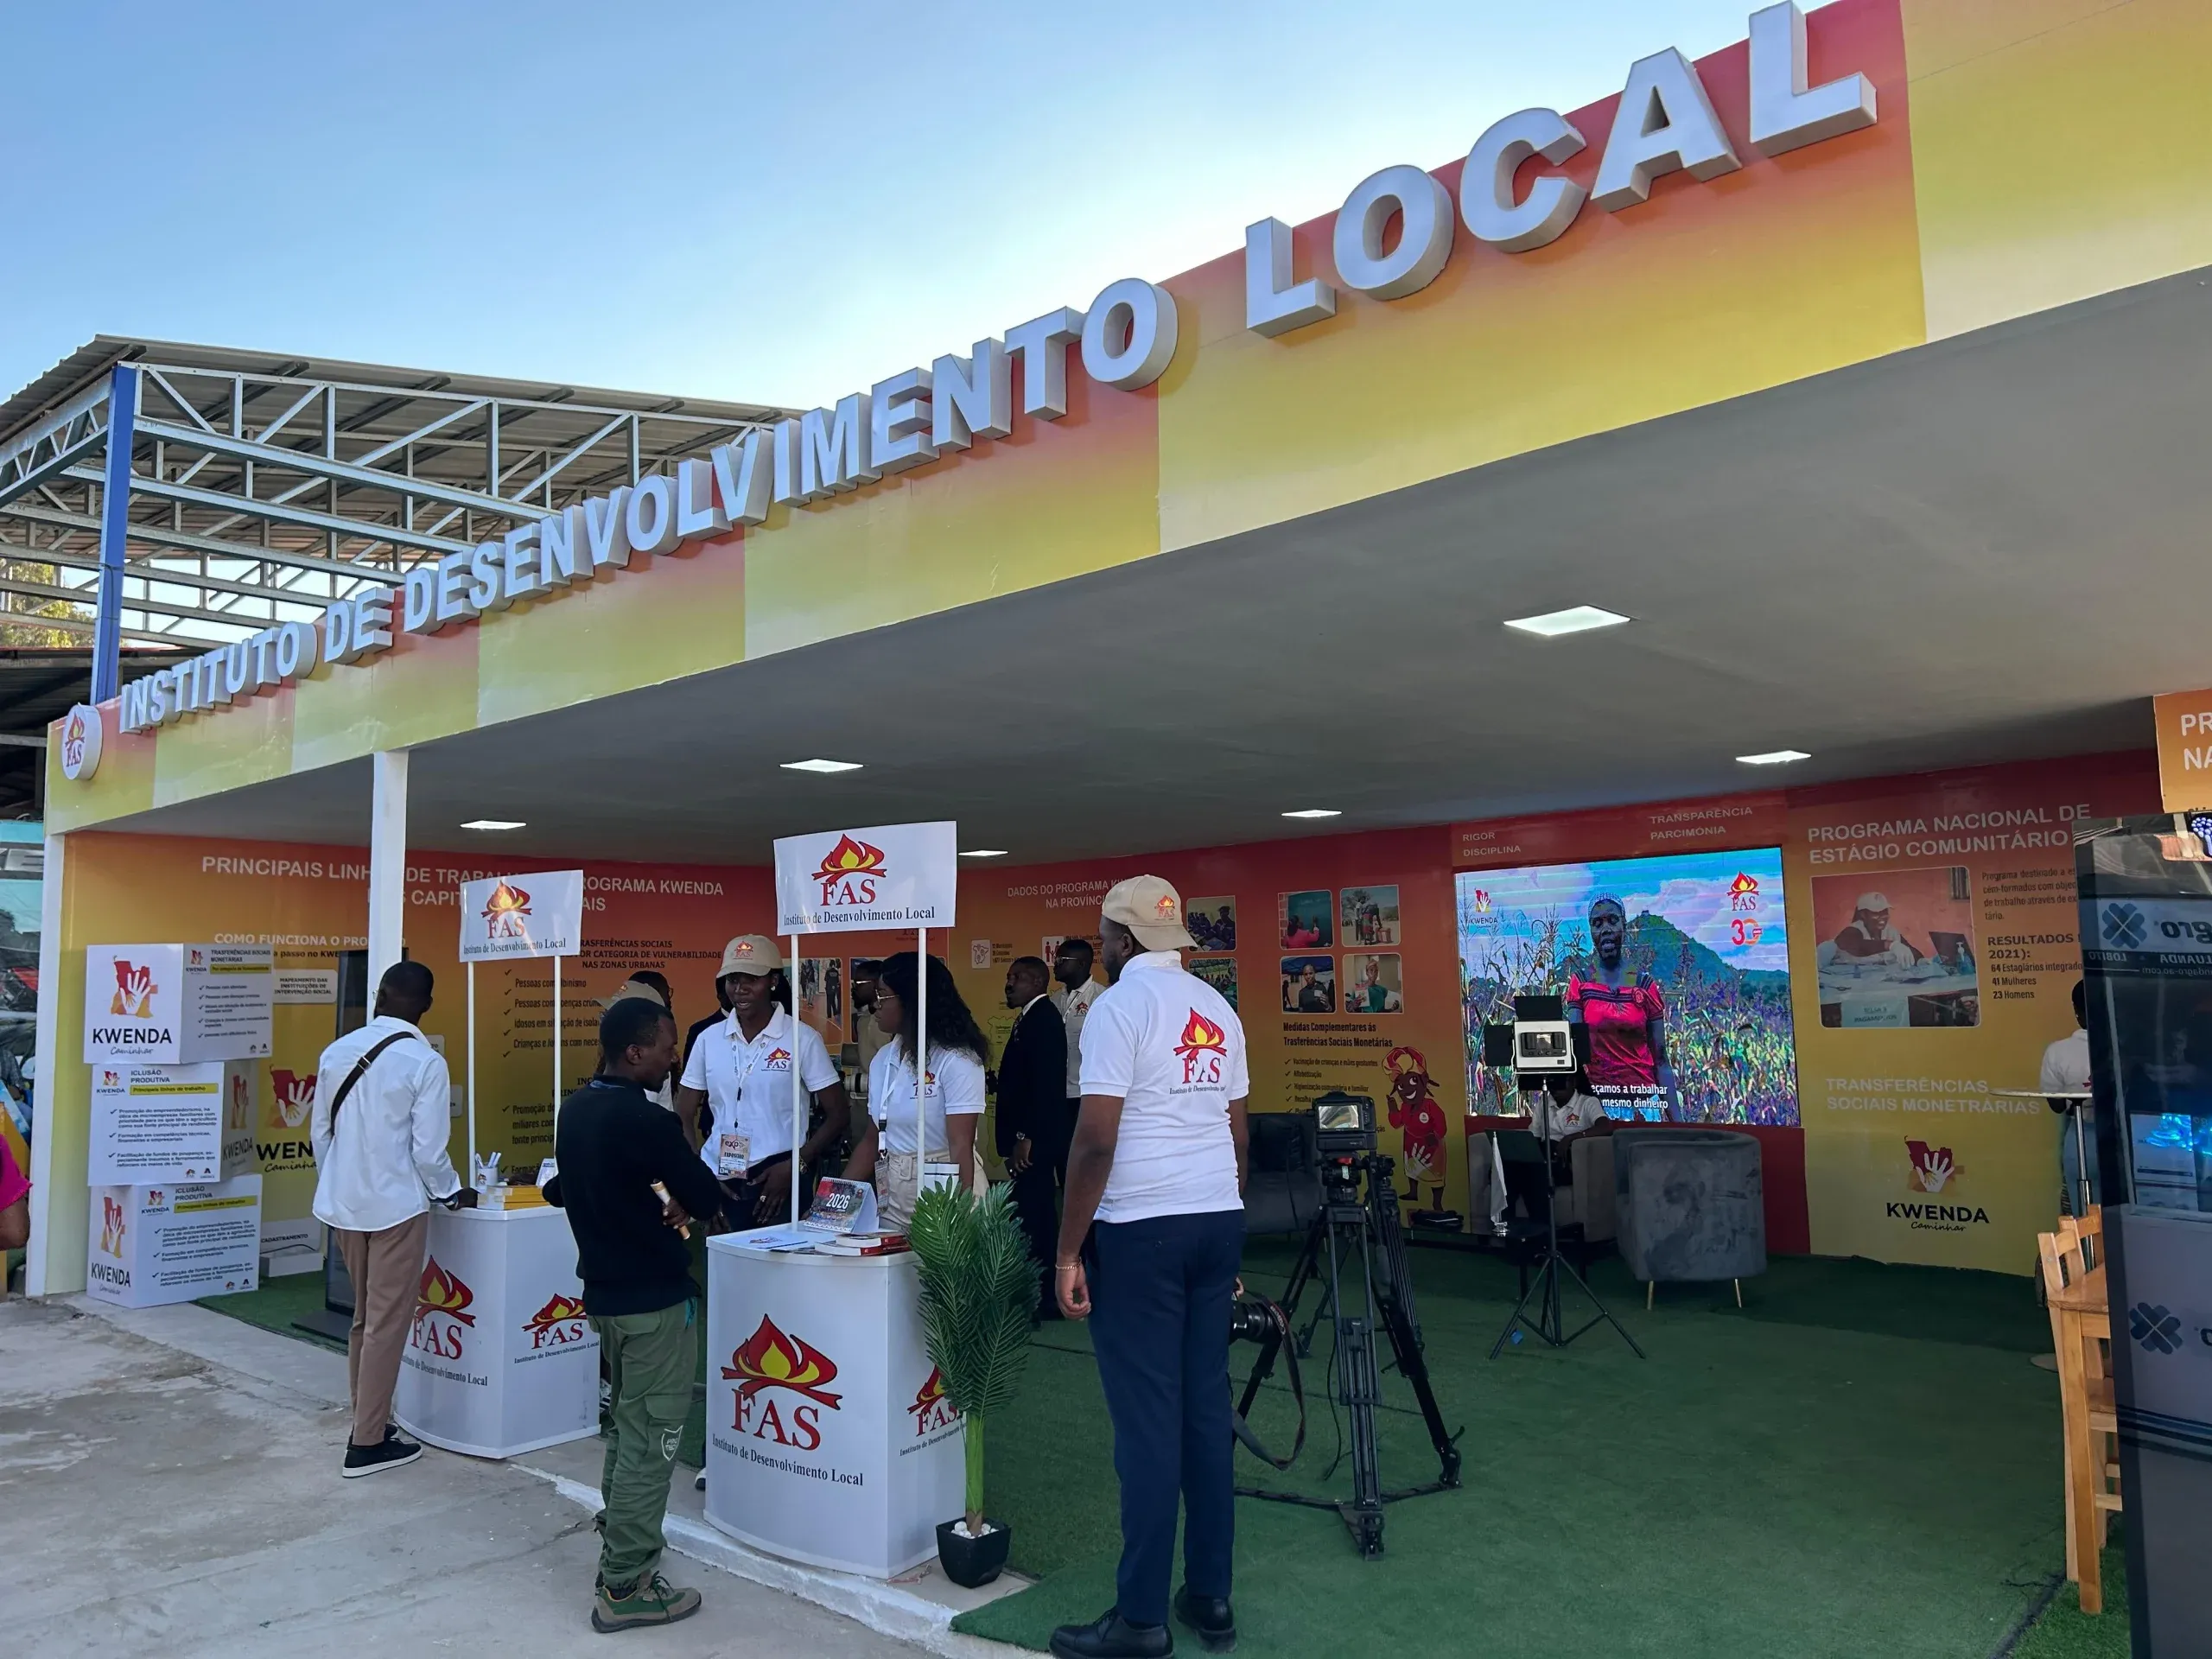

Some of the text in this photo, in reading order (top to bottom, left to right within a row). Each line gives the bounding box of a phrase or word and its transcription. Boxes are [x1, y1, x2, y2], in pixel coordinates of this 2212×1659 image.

[119, 0, 1877, 734] INSTITUTO DE DESENVOLVIMENTO LOCAL
[66, 743, 82, 767] FAS
[1808, 804, 2091, 842] PROGRAMA NACIONAL DE
[1463, 831, 1495, 842] RIGOR
[1463, 844, 1521, 857] DISCIPLINA
[1809, 829, 2069, 864] ESTÁGIO COMUNITÁRIO
[202, 855, 723, 895] PRINCIPAIS LINH DE OGRAMA KWENDA
[1982, 871, 2018, 882] Programa
[2020, 868, 2057, 878] destinado
[820, 879, 876, 906] FAS
[1007, 887, 1038, 898] DADOS
[1040, 885, 1053, 895] DO
[1055, 880, 1109, 893] PROGRAMA
[1046, 895, 1104, 909] NA PROVÍNC
[1731, 896, 1756, 911] FAS
[1983, 899, 1993, 907] de
[1994, 897, 2025, 906] trabalho
[2027, 896, 2055, 905] através
[2056, 894, 2066, 903] de
[784, 906, 935, 926] Instituto de Desenvolvimento Local
[487, 916, 524, 939] FAS
[214, 933, 340, 946] COMO FUNCIONA O
[544, 938, 566, 949] Local
[581, 938, 639, 948] RASFERÊNCIAS
[1987, 933, 2074, 946] RESULTADOS
[281, 951, 306, 960] passo
[653, 950, 721, 959] VULNERABILIDADE
[1989, 949, 2031, 960] 2021):
[1991, 963, 2000, 972] 64
[515, 978, 541, 988] Pessoas
[2001, 976, 2037, 986] Mulheres
[2004, 990, 2035, 999] Homens
[514, 999, 541, 1007] Pessoas
[575, 1018, 582, 1027] de
[1283, 1022, 1310, 1032] Medidas
[1311, 1022, 1367, 1033] Complementares
[92, 1028, 172, 1045] KWENDA
[1329, 1037, 1353, 1046] Sociais
[1353, 1038, 1393, 1047] Monetárias
[111, 1046, 154, 1055] Caminhar
[513, 1039, 541, 1049] Crianças
[766, 1060, 787, 1069] FAS
[1630, 1084, 1668, 1094] trabalhar
[1826, 1077, 1988, 1094] TRANSFERÊNCIAS
[1602, 1097, 1669, 1109] mesmo dinheiro
[1827, 1096, 1897, 1111] SOCIAIS
[223, 1137, 252, 1160] KWENDA
[256, 1141, 314, 1160] WEN
[264, 1160, 317, 1173] Caminha
[826, 1192, 850, 1209] 2026
[141, 1206, 169, 1215] KWENDA
[1886, 1202, 1990, 1224] KWENDA
[1910, 1221, 1967, 1232] Caminhar
[261, 1233, 308, 1243] CADASTRAMENTO
[91, 1262, 130, 1287] KWENDA
[410, 1314, 462, 1360] FAS
[531, 1322, 583, 1350] FAS
[514, 1354, 537, 1363] Instituto
[587, 1340, 600, 1349] Local
[467, 1373, 488, 1386] Local
[731, 1388, 822, 1452] FAS
[916, 1402, 957, 1437] FAS
[899, 1444, 921, 1456] Instituto
[922, 1440, 927, 1449] de
[712, 1433, 864, 1487] Instituto de Desenvolvimento Local
